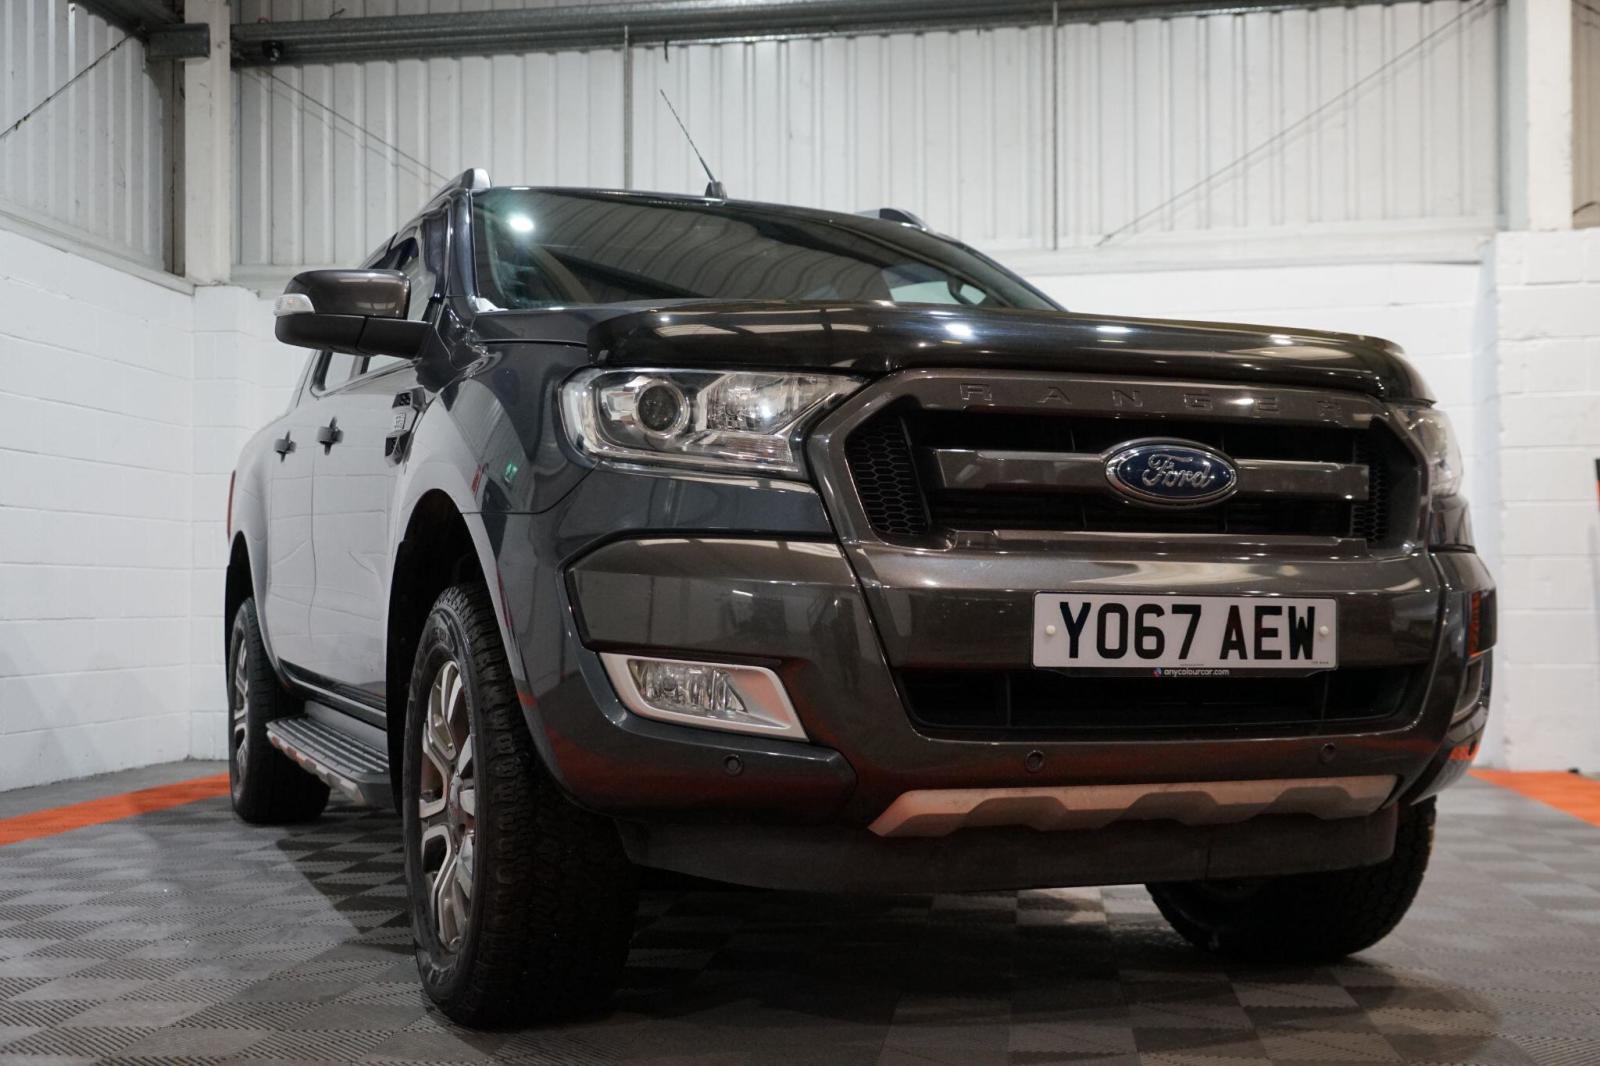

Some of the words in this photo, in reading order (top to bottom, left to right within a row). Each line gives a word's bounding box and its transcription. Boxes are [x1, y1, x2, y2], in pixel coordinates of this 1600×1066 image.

[960, 383, 1343, 421] RANGER
[1142, 454, 1211, 488] Ford
[1060, 602, 1202, 660] YO67
[1219, 605, 1315, 660] AEW
[1163, 668, 1230, 678] anycolourcar.com
